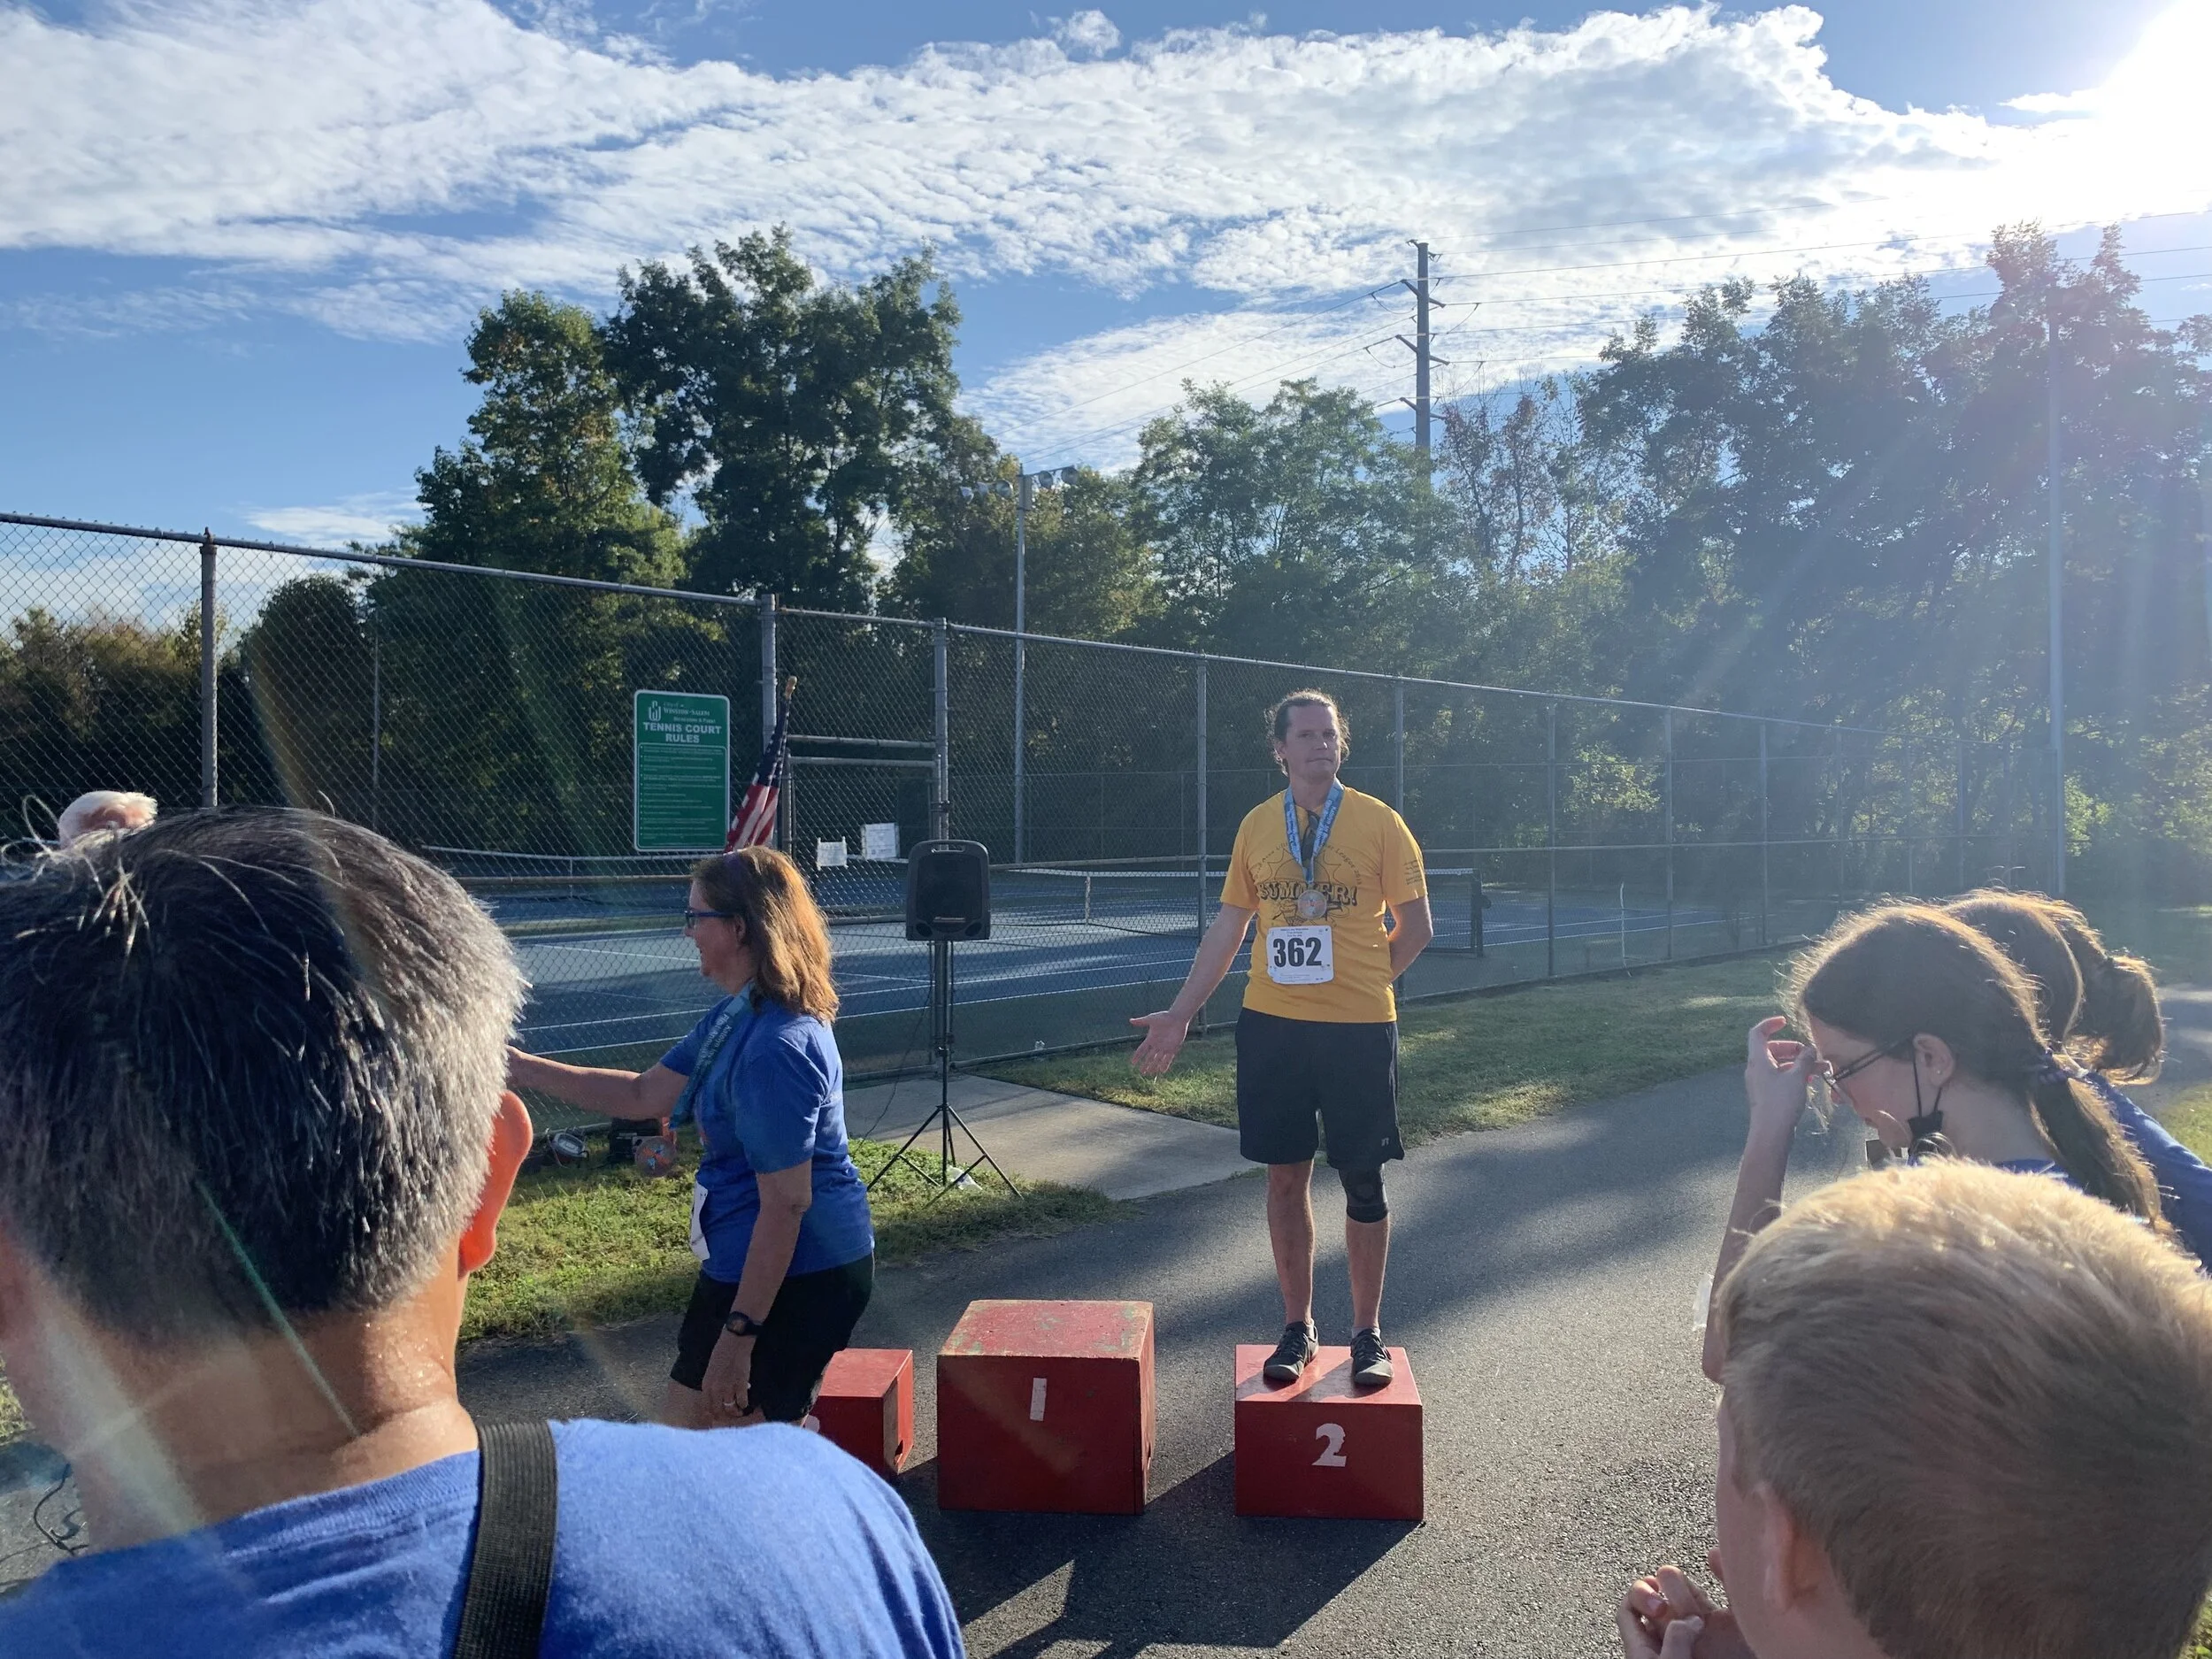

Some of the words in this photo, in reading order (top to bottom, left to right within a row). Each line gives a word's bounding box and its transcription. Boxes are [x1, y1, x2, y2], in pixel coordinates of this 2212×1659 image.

[643, 722, 682, 733] TENNIS
[686, 724, 722, 734] COURT
[665, 733, 700, 743] RULES
[1273, 937, 1322, 968] 362
[1030, 1378, 1048, 1422] 1
[1311, 1423, 1348, 1467] 2
